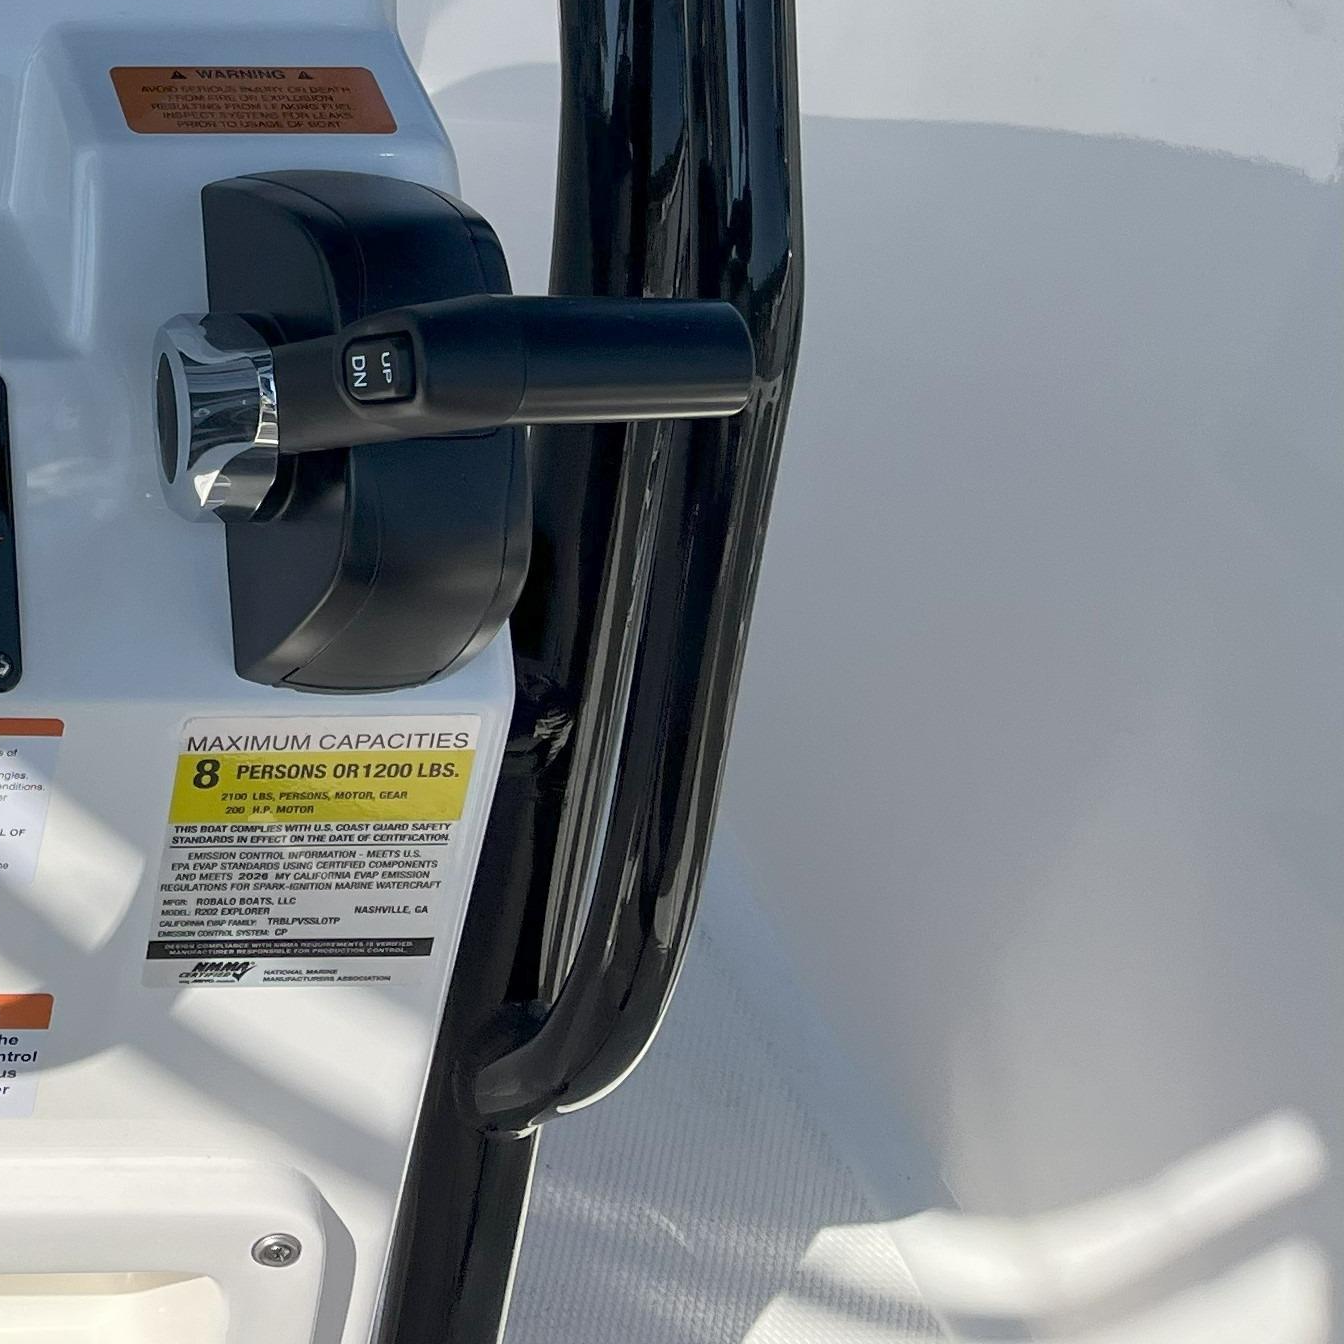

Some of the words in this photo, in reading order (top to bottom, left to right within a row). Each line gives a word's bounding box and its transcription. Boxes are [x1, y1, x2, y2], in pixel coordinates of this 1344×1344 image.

[196, 69, 286, 80] WARNING
[352, 354, 366, 388] DN
[380, 350, 394, 384] UP
[187, 734, 312, 752] MAXIMUM
[319, 732, 470, 750] CAPACITIES
[192, 758, 221, 789] 8
[236, 764, 328, 780] PERSONS
[332, 764, 360, 778] OR
[362, 762, 413, 778] 1200
[417, 762, 460, 778] LBS.
[220, 792, 248, 802] 2100
[252, 792, 276, 802] LBS,
[278, 792, 331, 802] PERSONS,
[334, 791, 376, 801] MOTOR,
[379, 790, 408, 800] GEAR
[225, 806, 245, 815] 200
[252, 805, 272, 814] H.P.
[276, 805, 314, 814] MOTOR
[10, 828, 26, 836] OF
[174, 824, 198, 834] THIS
[200, 824, 228, 834] BOAT
[230, 824, 282, 834] COMPLIES
[284, 824, 312, 833] WITH
[313, 823, 333, 832] U.S.
[336, 823, 371, 832] COAST
[372, 822, 409, 832] GUARD
[412, 822, 452, 832] SAFETY
[172, 836, 234, 844] STANDARDS
[236, 835, 248, 844] IN
[250, 834, 288, 844] EFFECT
[290, 834, 305, 843] ON
[306, 834, 325, 843] THE
[328, 834, 355, 842] DATE
[357, 834, 372, 842] OF
[372, 833, 450, 842] CERTIFICATION.
[188, 852, 236, 860] EMISSION
[238, 851, 285, 860] CONTROL
[288, 850, 356, 860] INFORMATION
[366, 850, 401, 858] MEETS
[403, 850, 422, 858] U.S.
[171, 862, 190, 871] EPA
[192, 862, 218, 871] EVAP
[220, 862, 280, 870] STANDARDS
[282, 861, 313, 870] USING
[316, 860, 366, 870] CERTIFIED
[368, 860, 438, 869] COMPONENTS
[175, 873, 196, 882] AND
[199, 872, 233, 881] MEETS
[238, 872, 269, 880] 2026
[274, 872, 292, 880] MY
[293, 872, 351, 880] CALIFORNIA
[354, 871, 379, 880] EVAP
[381, 870, 430, 879] EMISSION
[160, 883, 228, 892] REGULATIONS
[230, 883, 250, 891] FOR
[253, 882, 332, 891] SPARK-IGNITION
[334, 881, 373, 890] MARINE
[376, 880, 442, 890] WATERCRAFT
[196, 898, 236, 906] ROBALO
[278, 897, 296, 905] LLC
[354, 906, 411, 914] NASHVILLE,
[414, 906, 428, 914] GA
